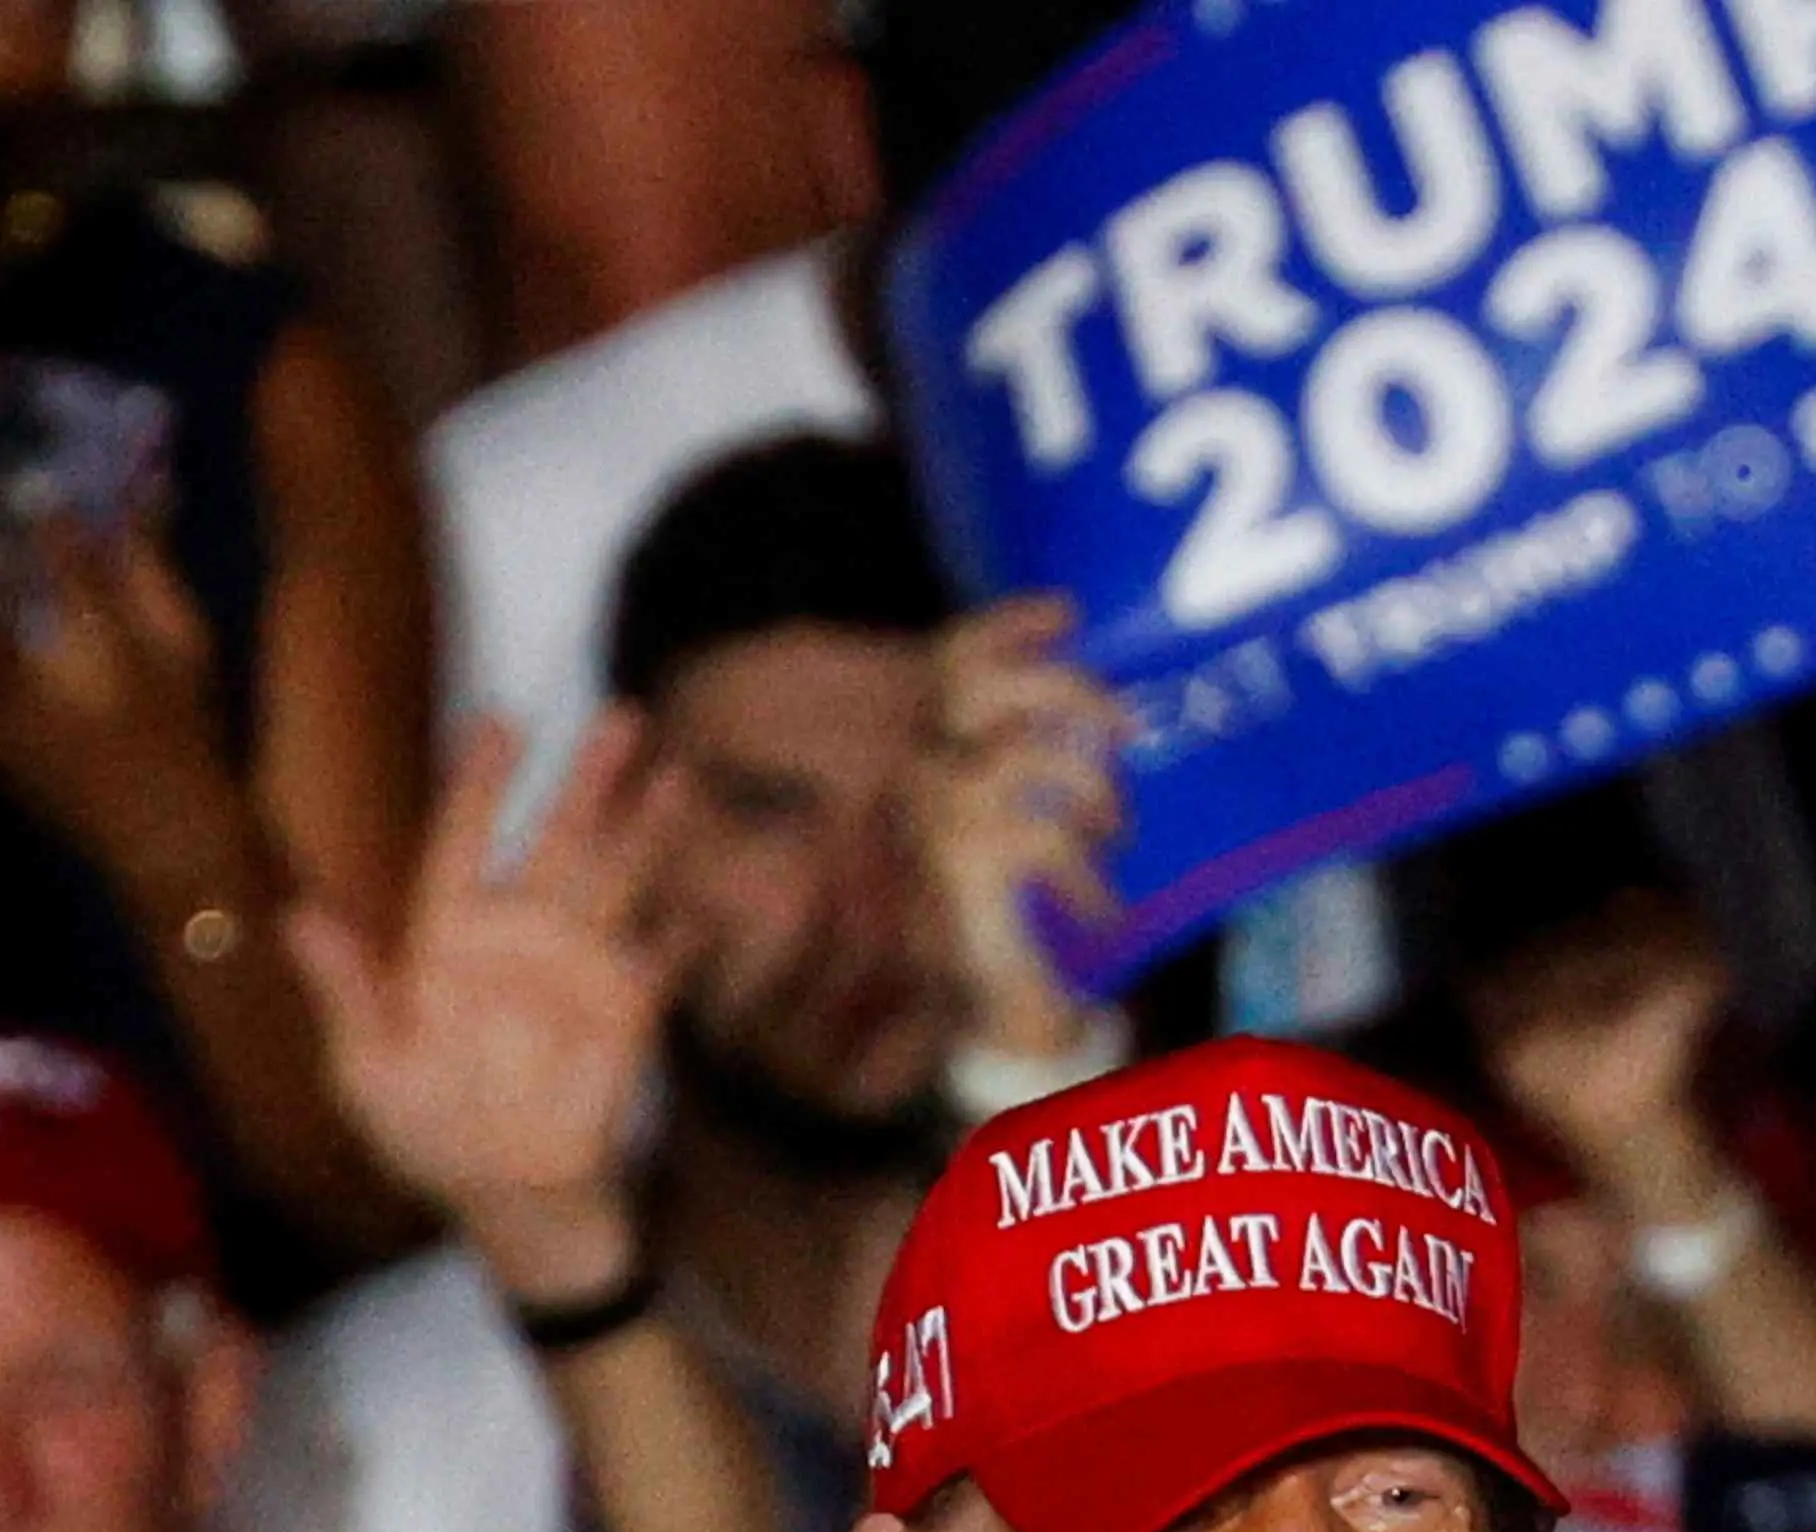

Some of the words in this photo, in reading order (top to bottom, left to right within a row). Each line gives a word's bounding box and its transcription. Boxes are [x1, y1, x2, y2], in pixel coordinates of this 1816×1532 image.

[1122, 638, 1294, 768] EXT
[1300, 490, 1638, 690] TRUMP
[1648, 424, 1786, 534] TO
[988, 1103, 1205, 1230] MAKE
[1216, 1091, 1497, 1226] AMERICA
[1048, 1213, 1279, 1334] GREAT
[1300, 1212, 1474, 1332] AGAIN
